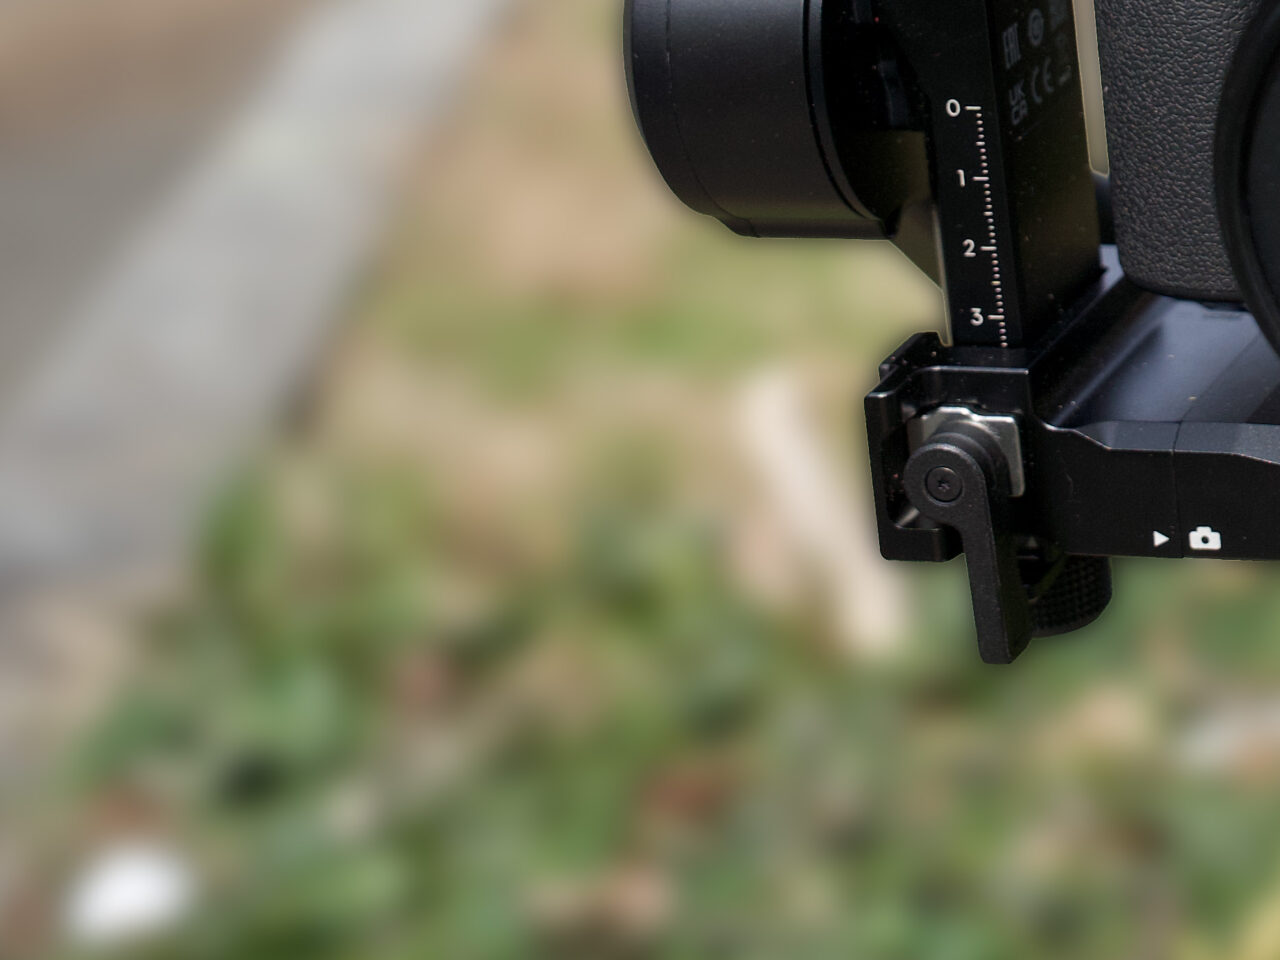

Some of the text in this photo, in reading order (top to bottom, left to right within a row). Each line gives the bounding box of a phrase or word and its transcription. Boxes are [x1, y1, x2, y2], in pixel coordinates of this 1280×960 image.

[945, 98, 961, 118] 0
[956, 168, 966, 188] 1
[962, 239, 977, 258] 2
[970, 307, 984, 327] 3
